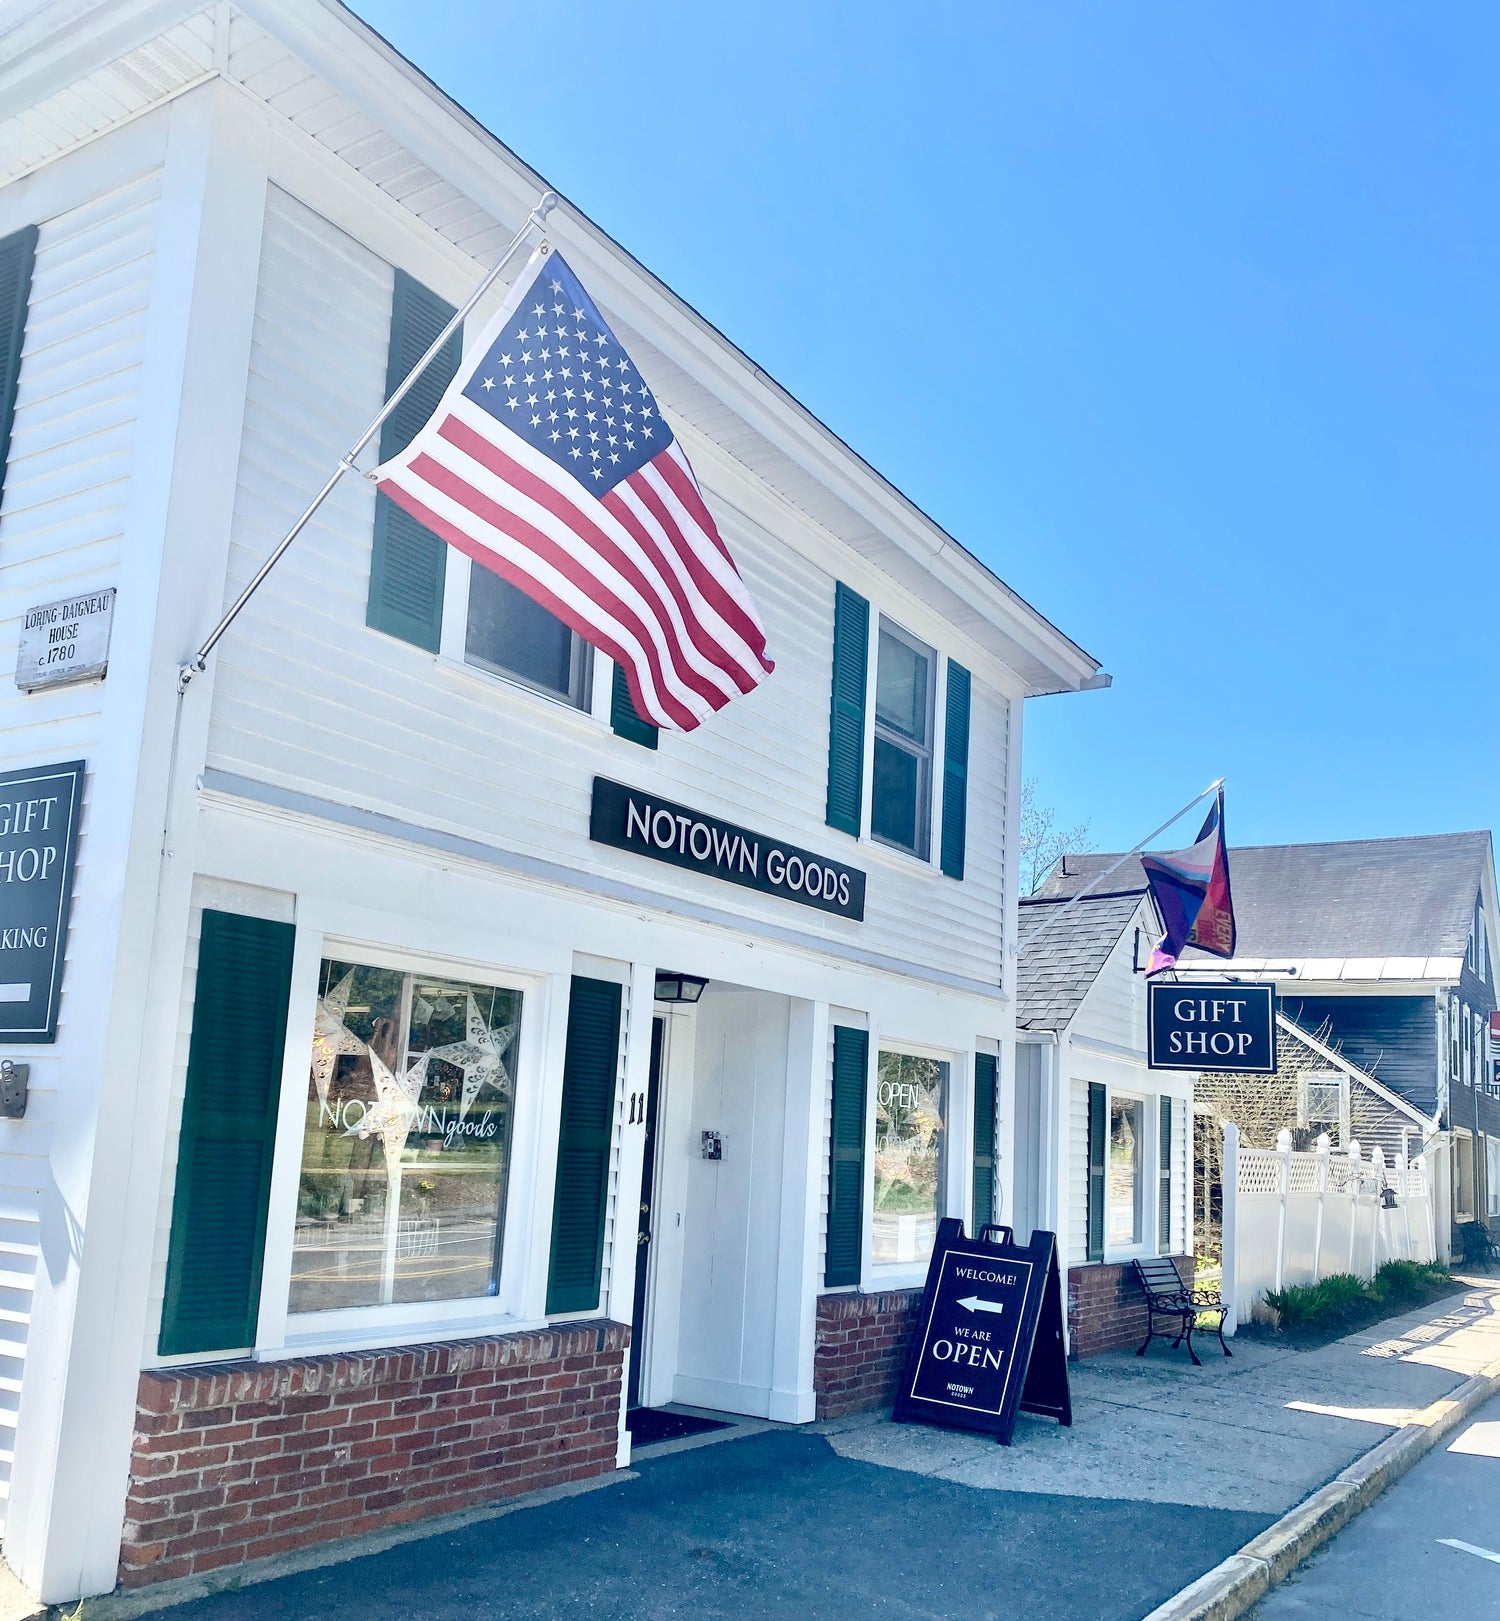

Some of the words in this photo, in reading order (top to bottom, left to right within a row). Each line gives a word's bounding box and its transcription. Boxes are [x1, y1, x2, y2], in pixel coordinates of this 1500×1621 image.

[48, 622, 79, 644] HOUSE
[627, 798, 758, 877] NOTOWN
[766, 849, 851, 906] GOODS
[0, 926, 48, 950] KING
[1173, 999, 1247, 1023] GIFT
[1169, 1030, 1253, 1056] SHOP
[879, 1081, 920, 1109] OPEN
[628, 1092, 645, 1125] 11
[443, 1109, 498, 1148] goods
[955, 1266, 1017, 1286] WELCOME!
[954, 1326, 971, 1339] WE
[972, 1329, 992, 1342] ARE
[932, 1339, 1005, 1371] OPEN
[946, 1382, 974, 1394] NOTOWN
